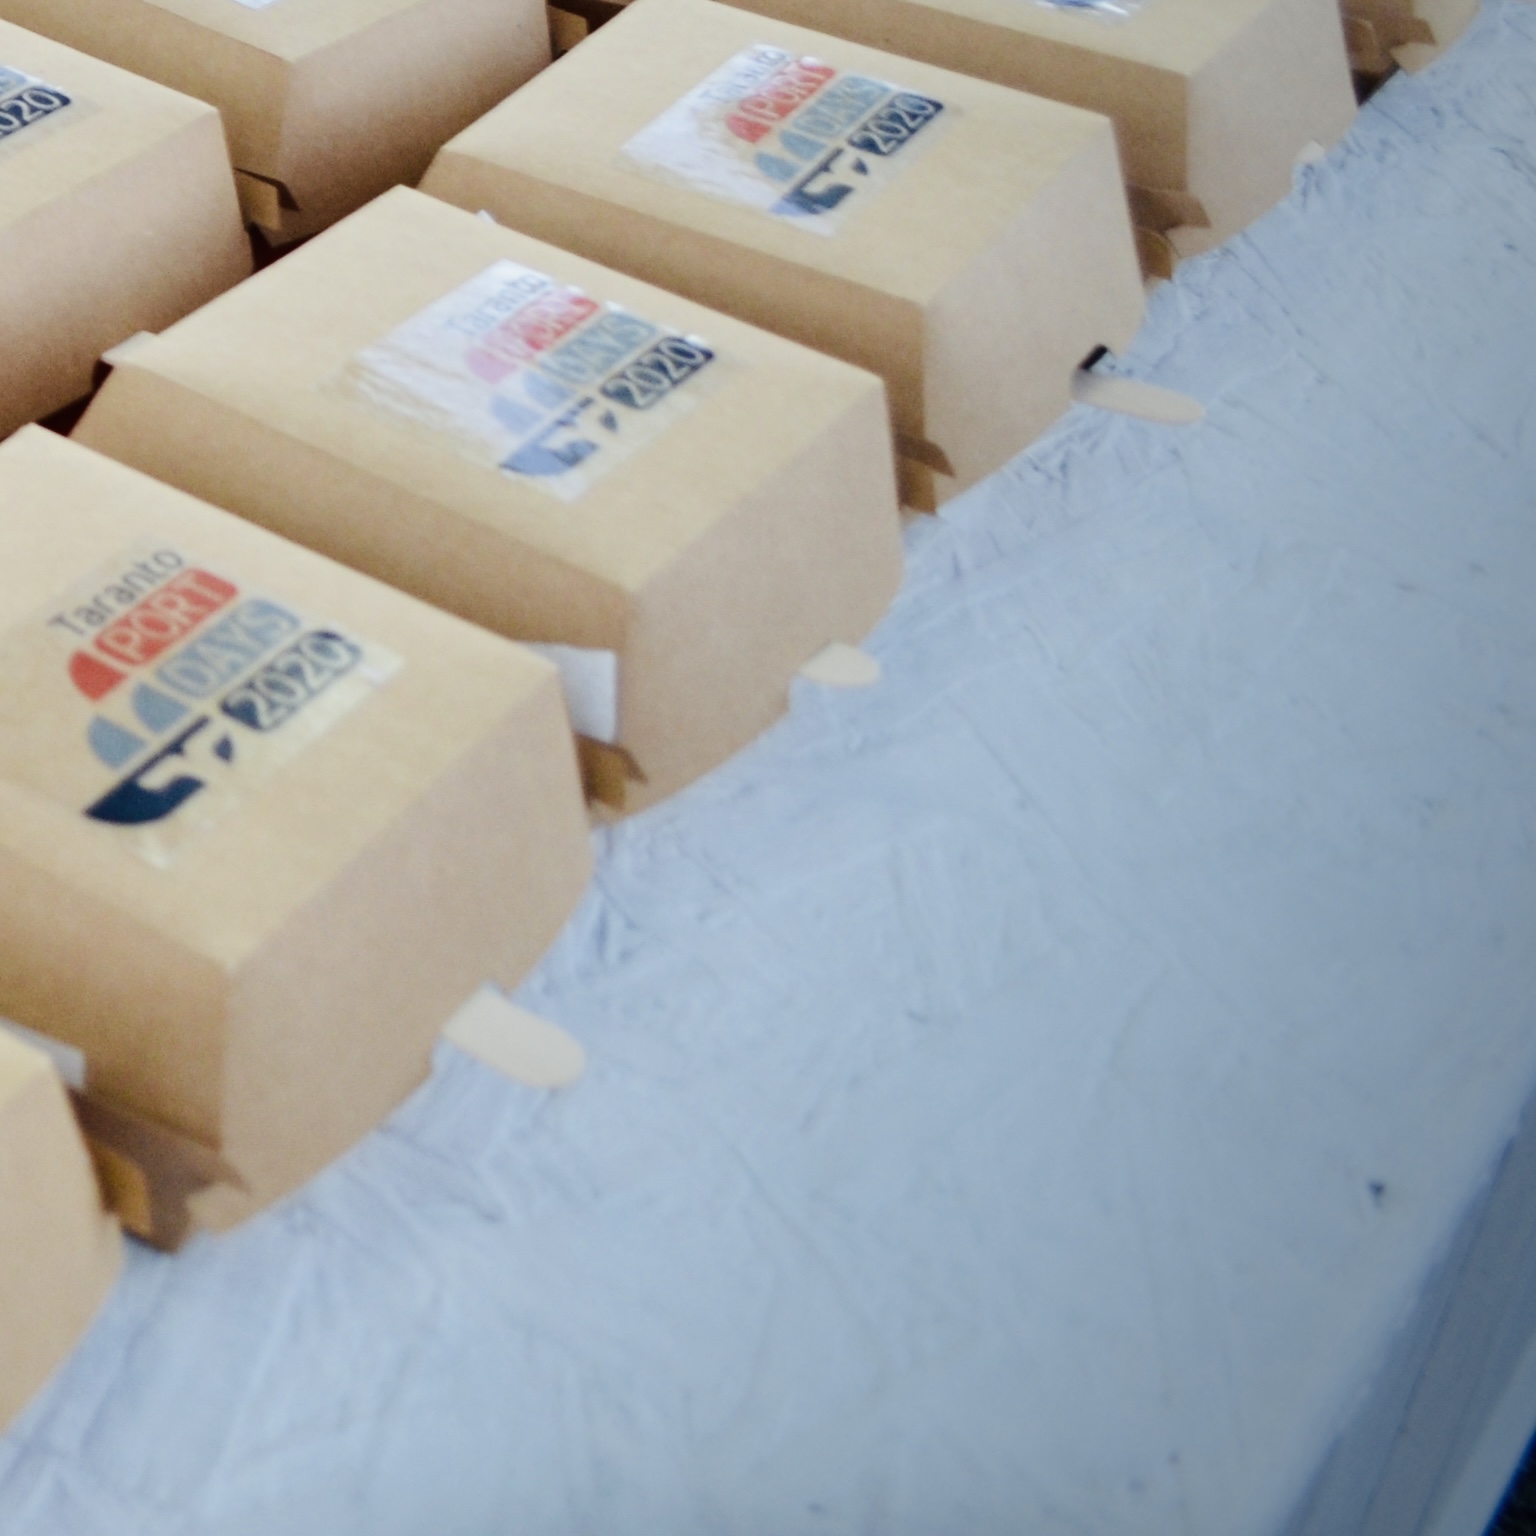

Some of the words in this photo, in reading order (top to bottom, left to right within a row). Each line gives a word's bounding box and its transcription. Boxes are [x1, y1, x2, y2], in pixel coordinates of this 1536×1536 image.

[740, 64, 826, 120] PORT
[794, 79, 885, 136] DAYS
[851, 95, 934, 154] 2020
[603, 337, 706, 407] 2020
[51, 551, 181, 640] Taranto
[102, 573, 222, 669] PORT
[166, 604, 289, 695] DAYS
[232, 633, 347, 727] 2020
